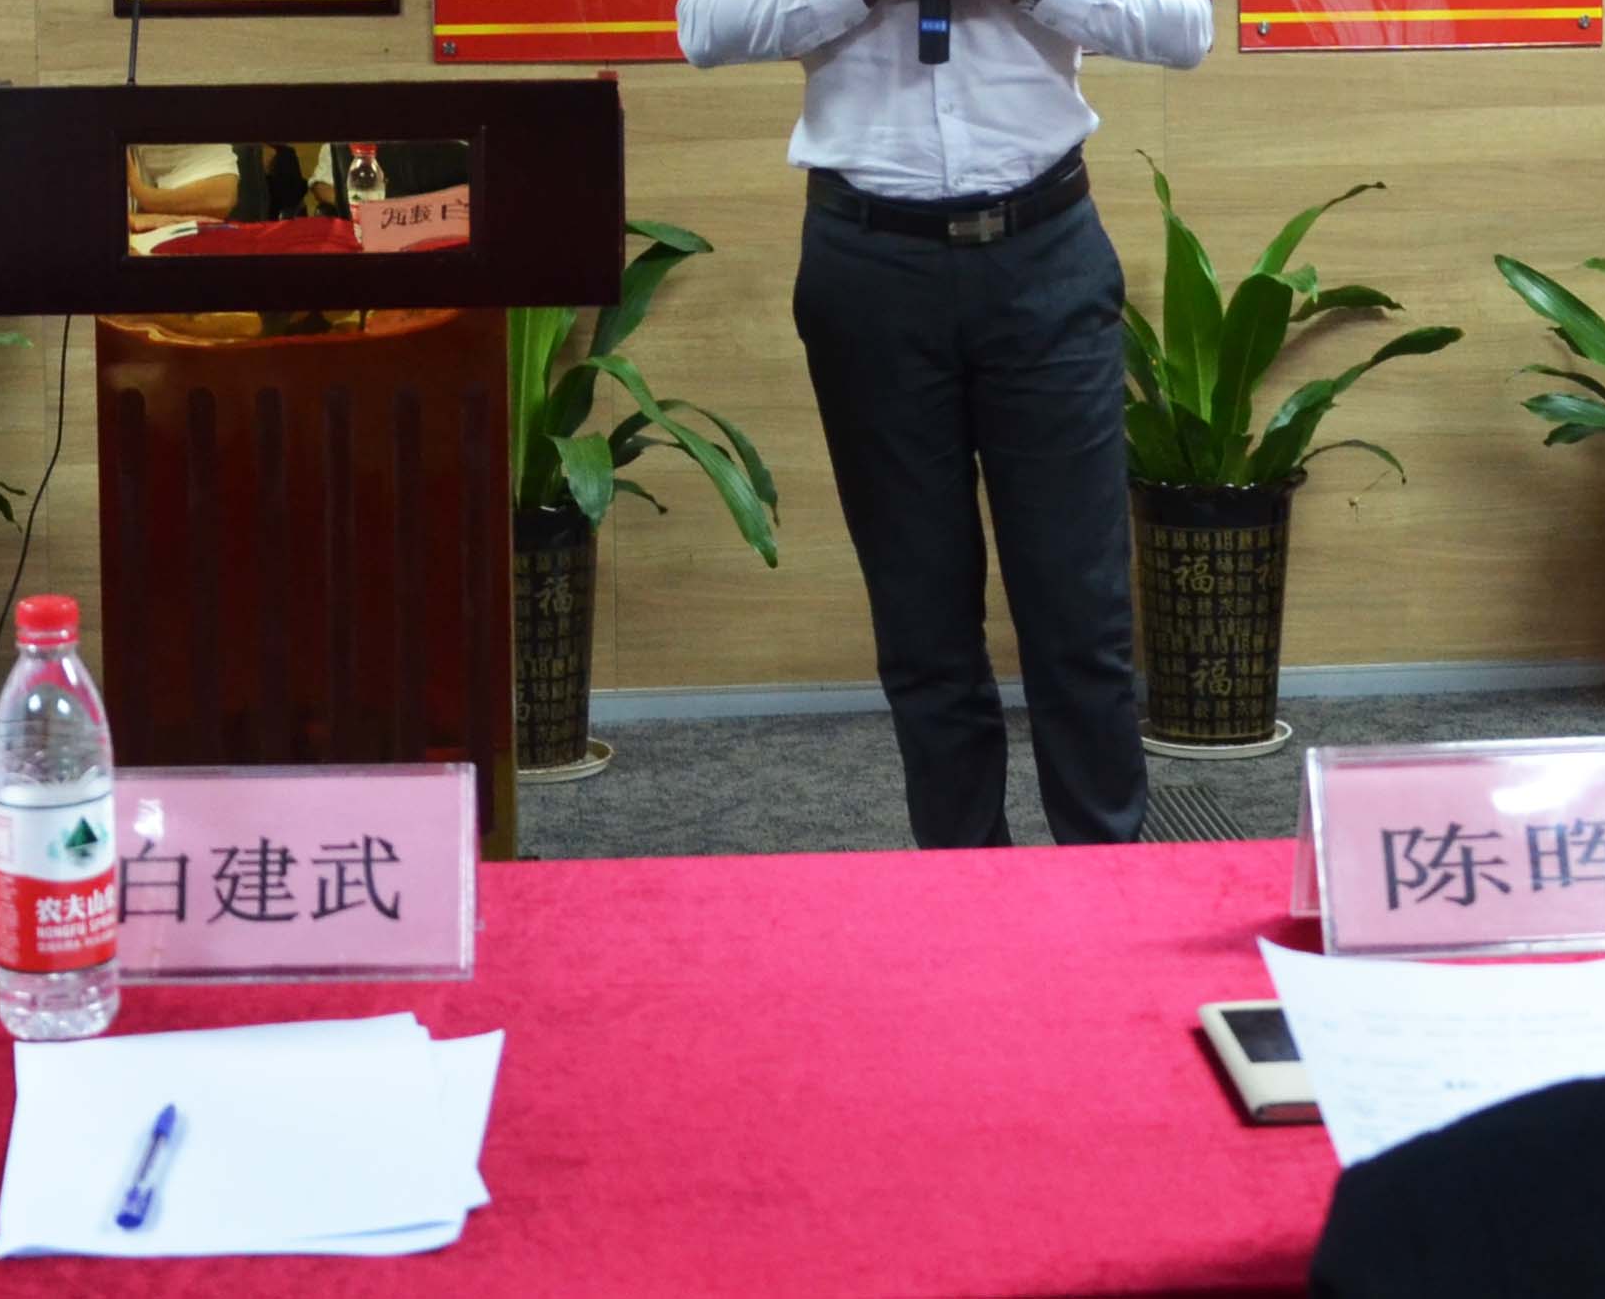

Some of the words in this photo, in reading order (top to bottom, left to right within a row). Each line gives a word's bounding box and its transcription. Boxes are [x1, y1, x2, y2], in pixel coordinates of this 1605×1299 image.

[1173, 554, 1215, 594] 福
[1191, 657, 1231, 696] 福
[117, 833, 401, 925] 白建武
